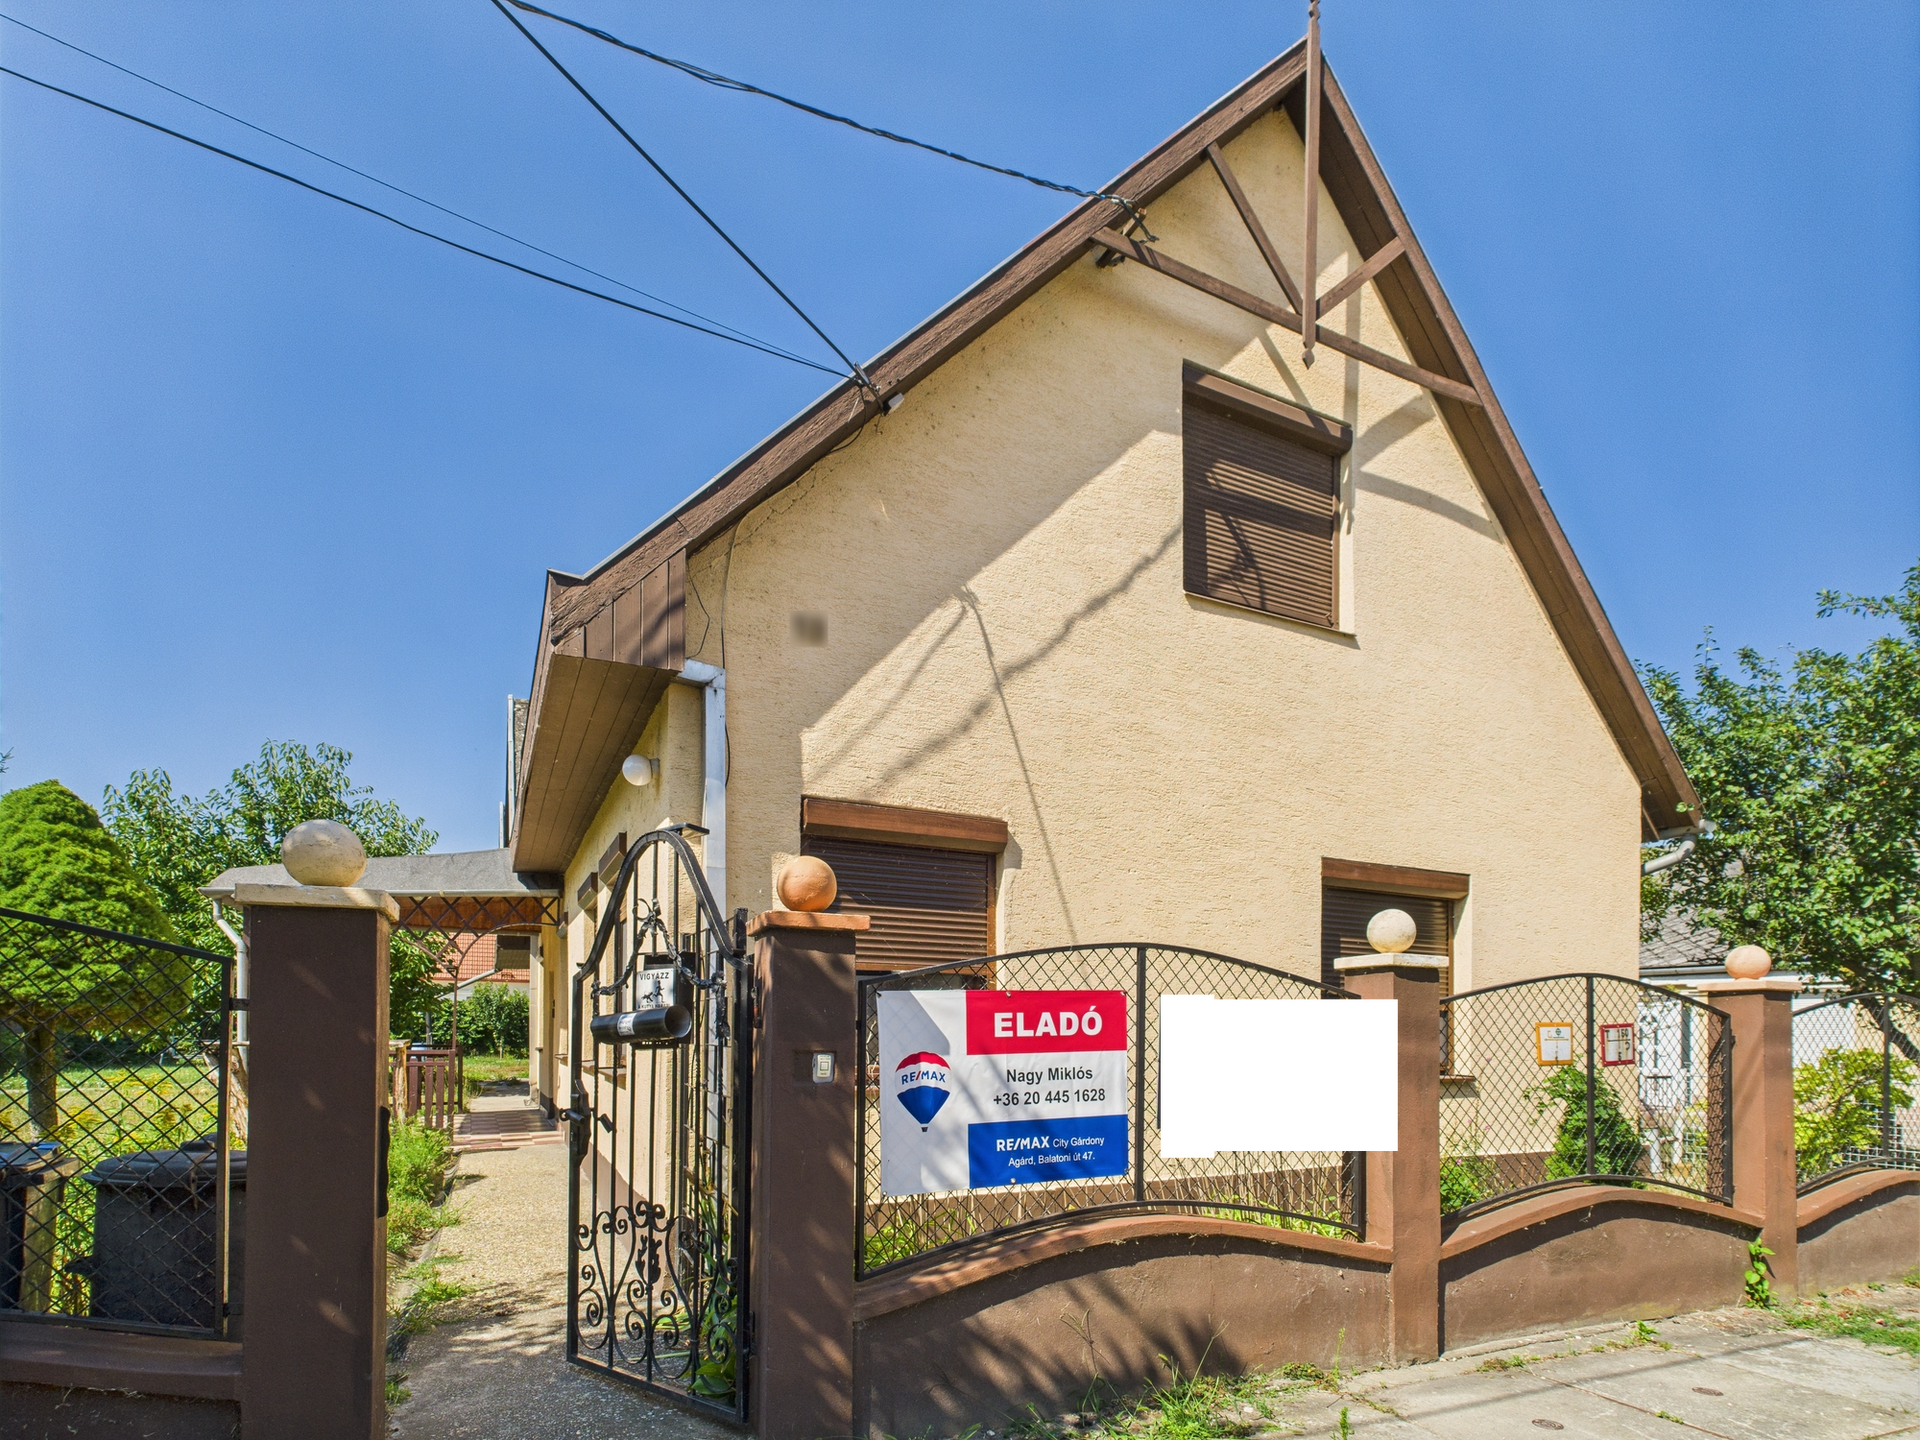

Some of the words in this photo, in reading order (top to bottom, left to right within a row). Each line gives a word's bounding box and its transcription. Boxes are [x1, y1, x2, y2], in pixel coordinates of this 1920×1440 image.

[994, 1005, 1103, 1037] ELADÓ
[901, 1070, 946, 1085] RE/MAX
[1006, 1069, 1043, 1085] Nagy
[1048, 1066, 1093, 1081] Miklós
[993, 1092, 1019, 1106] +36
[1024, 1091, 1040, 1105] 20
[1045, 1090, 1070, 1103] 445
[1074, 1088, 1106, 1102] 1628
[996, 1136, 1050, 1152] RE/MAX
[1052, 1138, 1069, 1149] City
[1070, 1136, 1105, 1147] Gárdony
[1008, 1156, 1036, 1168] Agárd,
[1038, 1153, 1072, 1165] Balatoni
[1072, 1152, 1081, 1162] út
[1082, 1151, 1096, 1161] 47.
